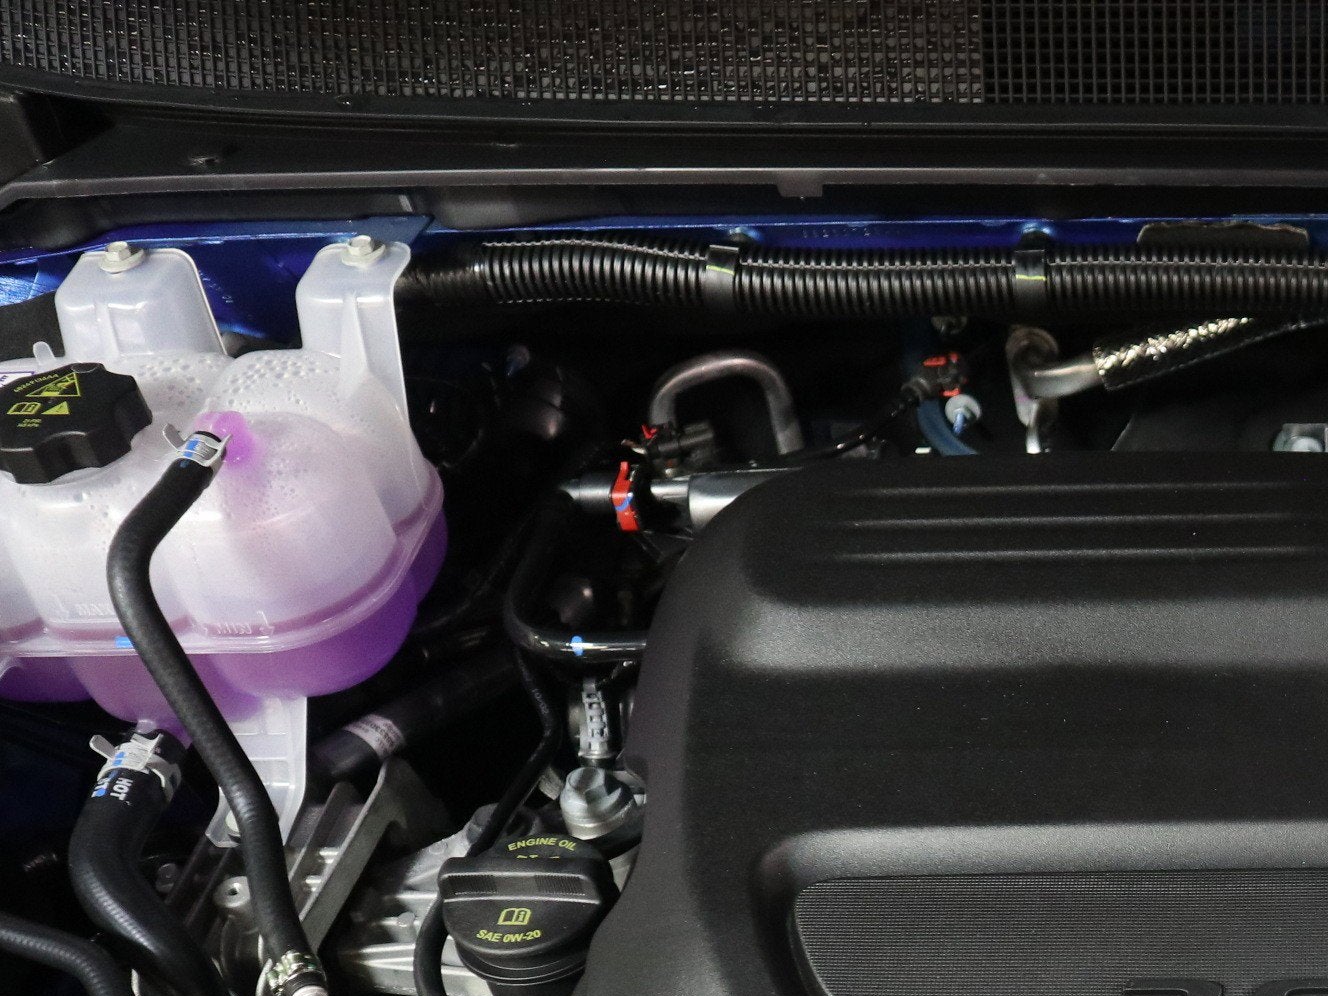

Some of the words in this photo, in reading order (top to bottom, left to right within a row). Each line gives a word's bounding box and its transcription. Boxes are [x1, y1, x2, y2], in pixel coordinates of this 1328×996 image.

[110, 777, 134, 801] HOT
[507, 837, 558, 851] ENGINE
[558, 839, 577, 851] OIL
[476, 929, 502, 943] SAE
[503, 929, 542, 943] 0W-20
